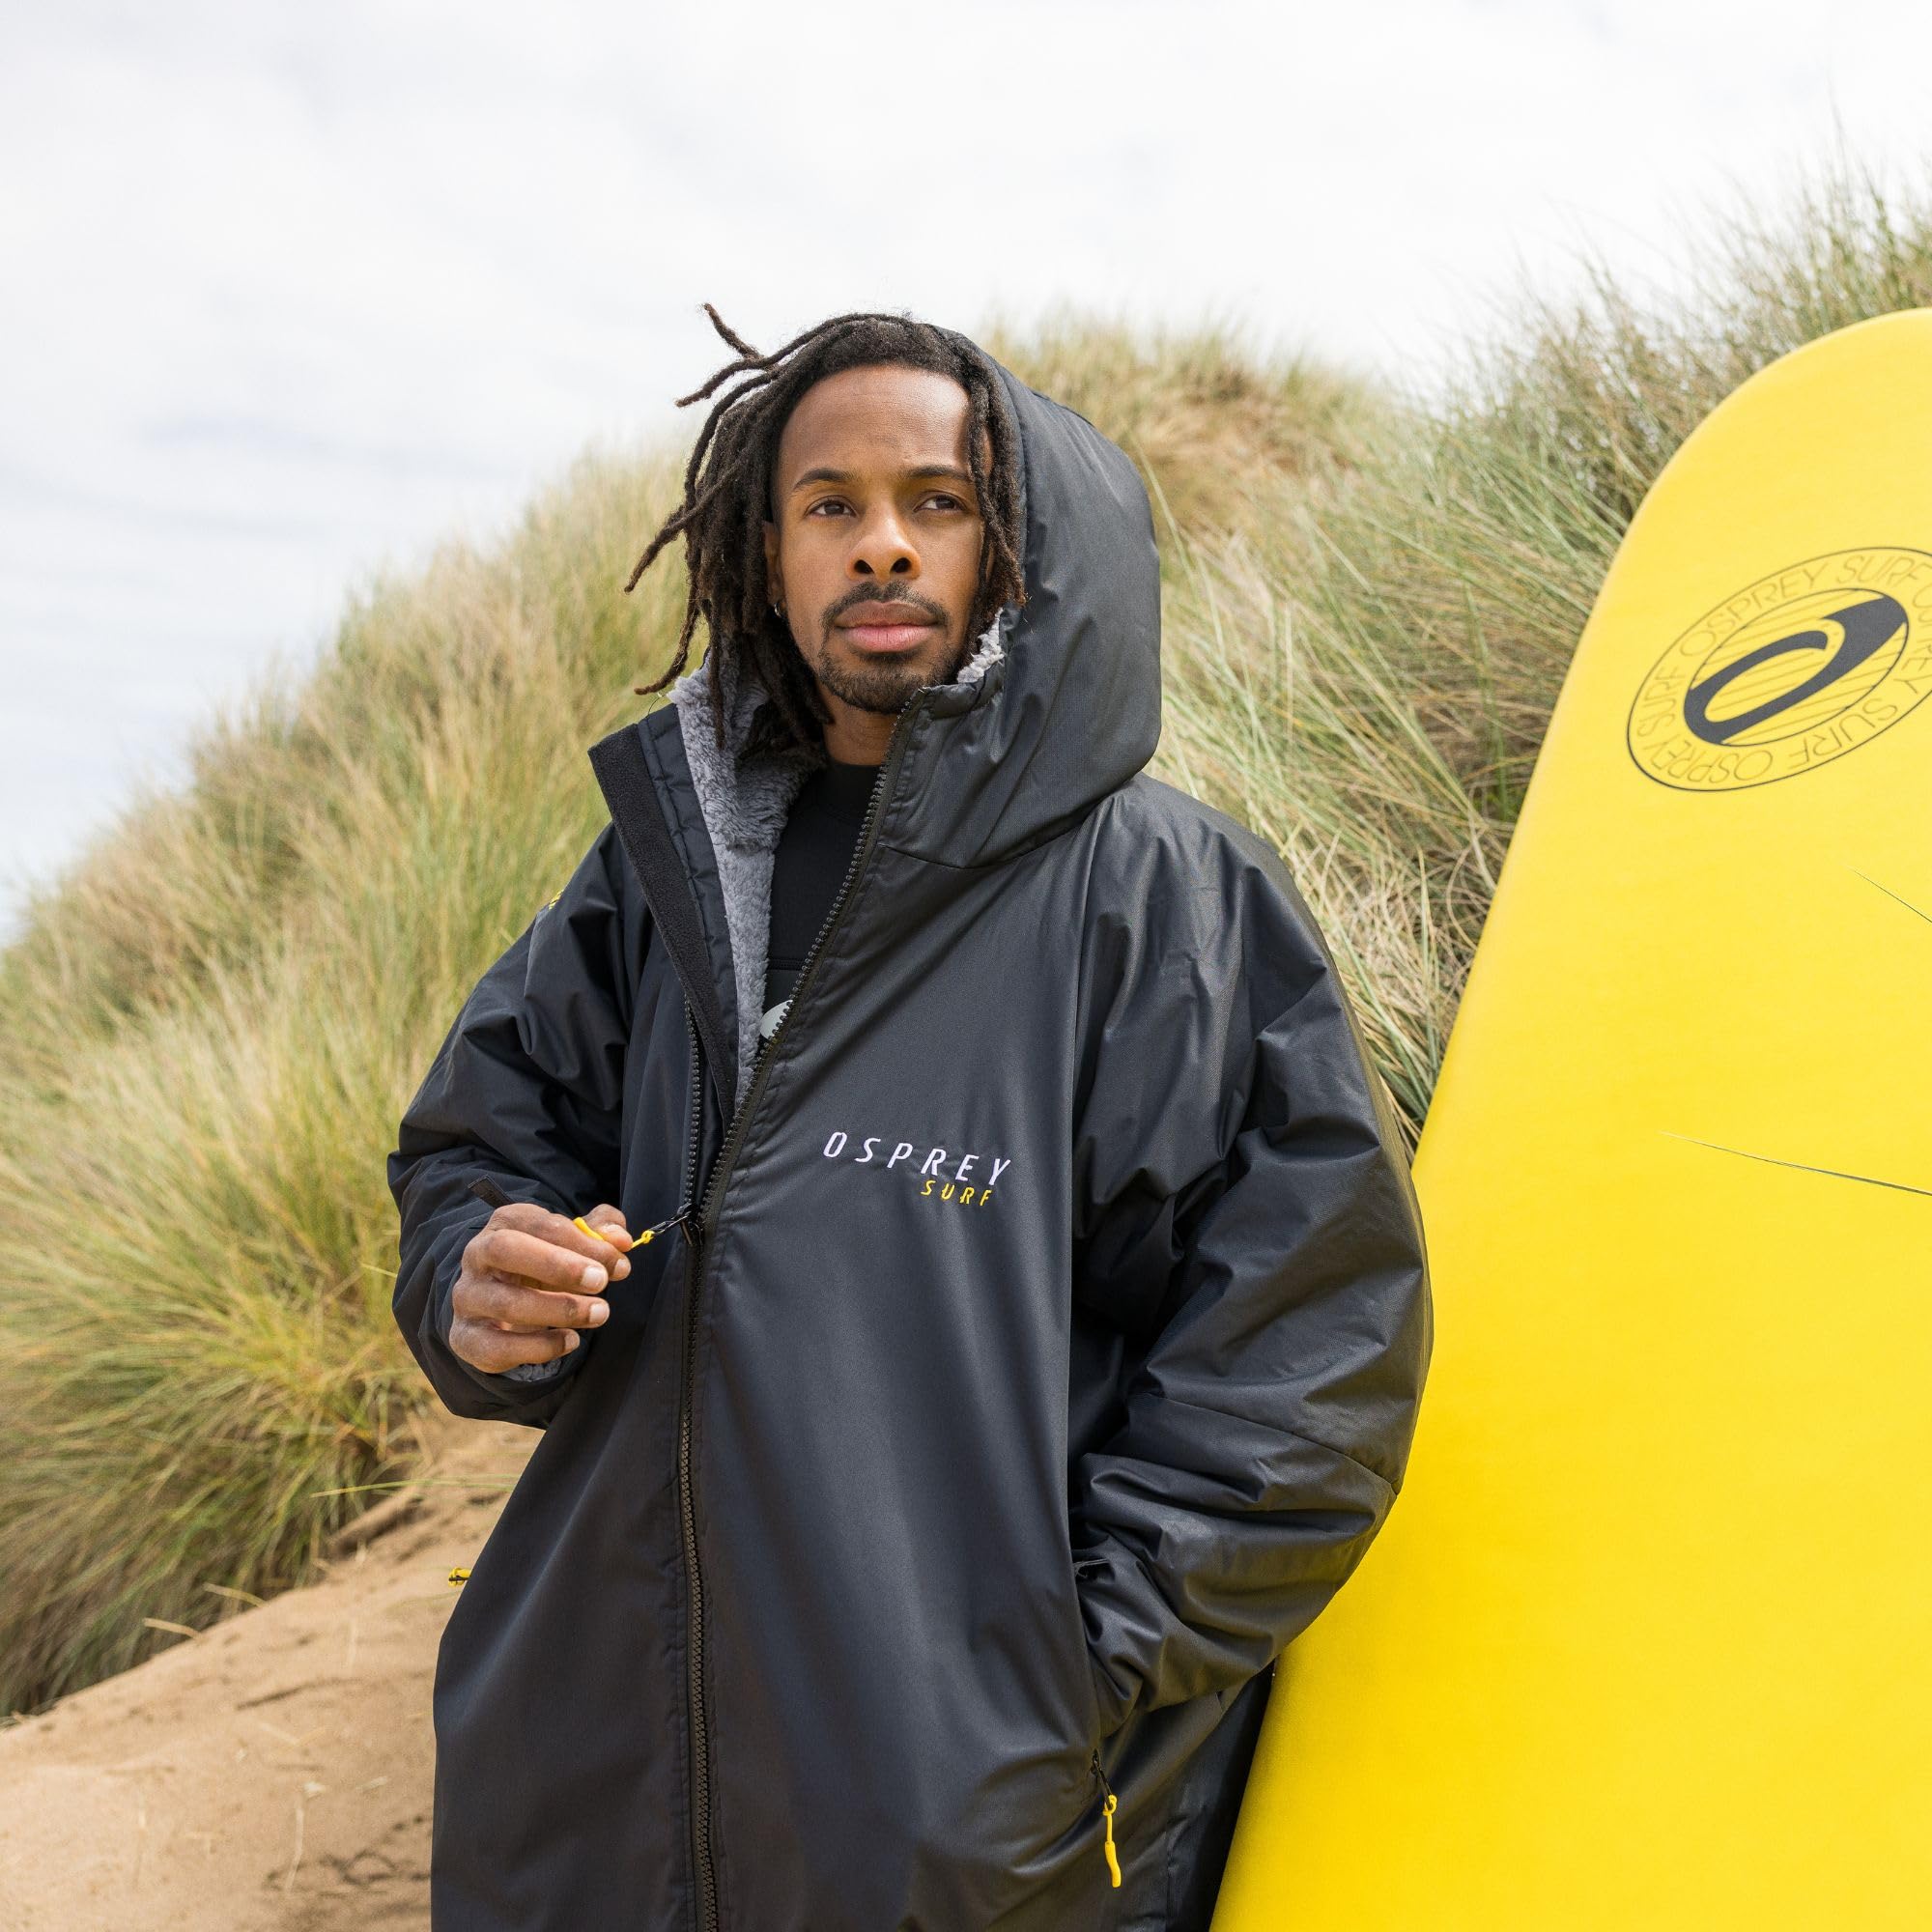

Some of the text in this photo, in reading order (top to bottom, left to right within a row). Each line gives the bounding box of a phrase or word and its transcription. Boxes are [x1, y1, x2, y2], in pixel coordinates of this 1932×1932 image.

[1835, 554, 1931, 585] SURF
[1680, 562, 1830, 657] OSPREY
[1636, 666, 1686, 737] SURF
[1643, 733, 1774, 784] OSPREY
[1789, 698, 1898, 768] SURF
[823, 1131, 1011, 1185] OSPREY
[920, 1179, 993, 1207] SURF
